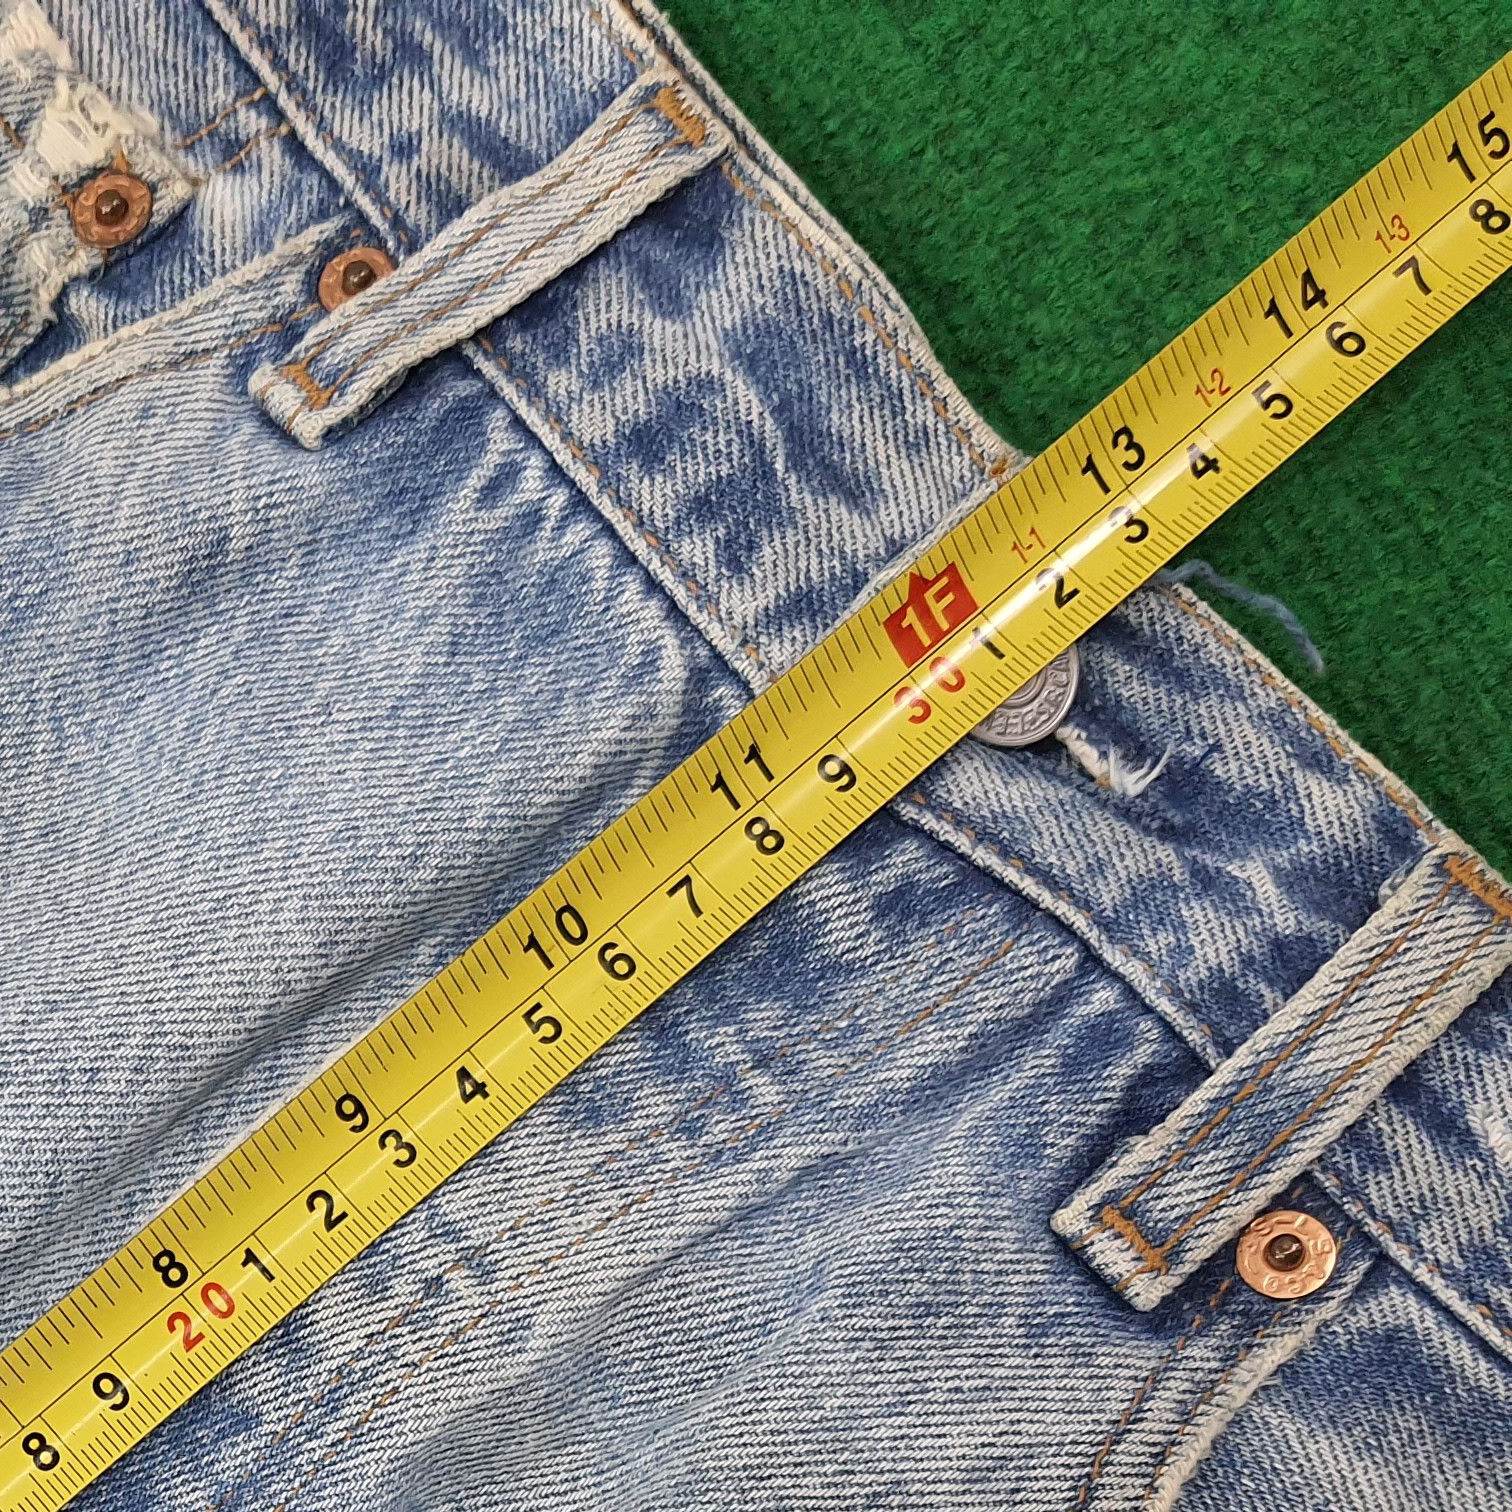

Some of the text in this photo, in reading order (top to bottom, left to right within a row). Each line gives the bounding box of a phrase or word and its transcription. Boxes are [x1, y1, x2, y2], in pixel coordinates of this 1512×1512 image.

[21, 1431, 61, 1472] 8
[91, 1370, 131, 1412] 9
[166, 1282, 236, 1353] 20
[241, 1247, 276, 1284] 1
[305, 1187, 348, 1232] 2
[377, 1128, 417, 1169] 3
[456, 1064, 489, 1105] 4
[522, 1002, 563, 1044] 5
[597, 941, 637, 982] 6
[666, 875, 707, 919] 7
[744, 816, 785, 856] 8
[817, 753, 858, 793] 9
[894, 656, 965, 724] 30
[971, 627, 1005, 660] 1
[1036, 567, 1080, 609] 2
[1109, 506, 1149, 544] 3
[1188, 442, 1222, 482] 4
[1251, 380, 1295, 422] 5
[1324, 320, 1367, 358] 6
[1393, 254, 1435, 298] 7
[1469, 199, 1511, 234] 8
[151, 1248, 189, 1288] 8
[335, 1092, 371, 1134] 9
[522, 903, 590, 973] 10
[710, 743, 776, 813] 11
[901, 576, 955, 648] 1F
[1011, 527, 1046, 564] 1-1
[1080, 425, 1147, 495] 13
[1194, 368, 1233, 407] 1-2
[1264, 268, 1328, 340] 14
[1374, 214, 1410, 253] 1-3
[1447, 111, 1510, 183] 15
